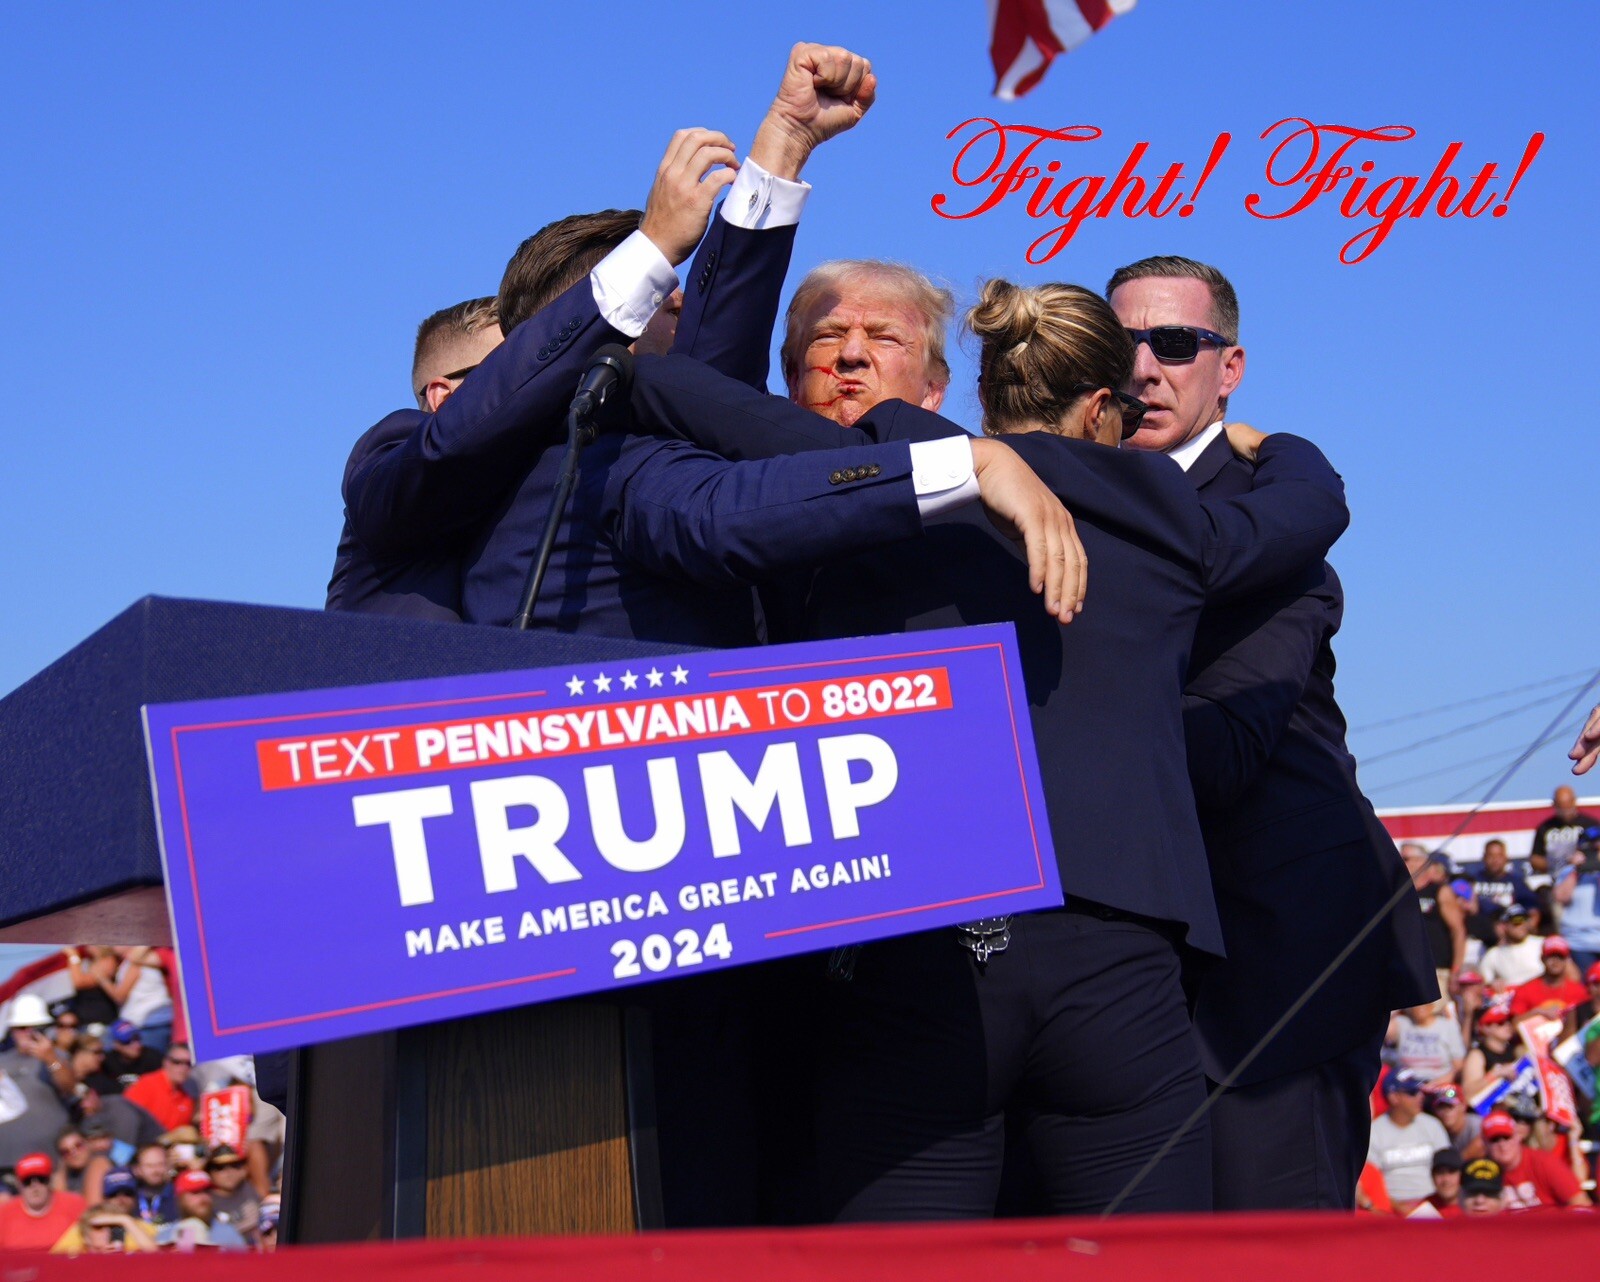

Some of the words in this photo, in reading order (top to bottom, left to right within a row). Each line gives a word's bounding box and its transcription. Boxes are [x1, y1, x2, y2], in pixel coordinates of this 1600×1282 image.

[277, 731, 401, 782] TEXT
[414, 695, 752, 768] PENNSYLVANIA
[756, 687, 812, 726] TO
[820, 673, 938, 719] 88022
[351, 733, 900, 908] TRUMP
[404, 916, 507, 958] MAKE
[517, 890, 670, 940] AMERICA
[677, 872, 779, 912] GREAT
[789, 853, 892, 893] AGAIN!
[609, 921, 734, 980] 2024
